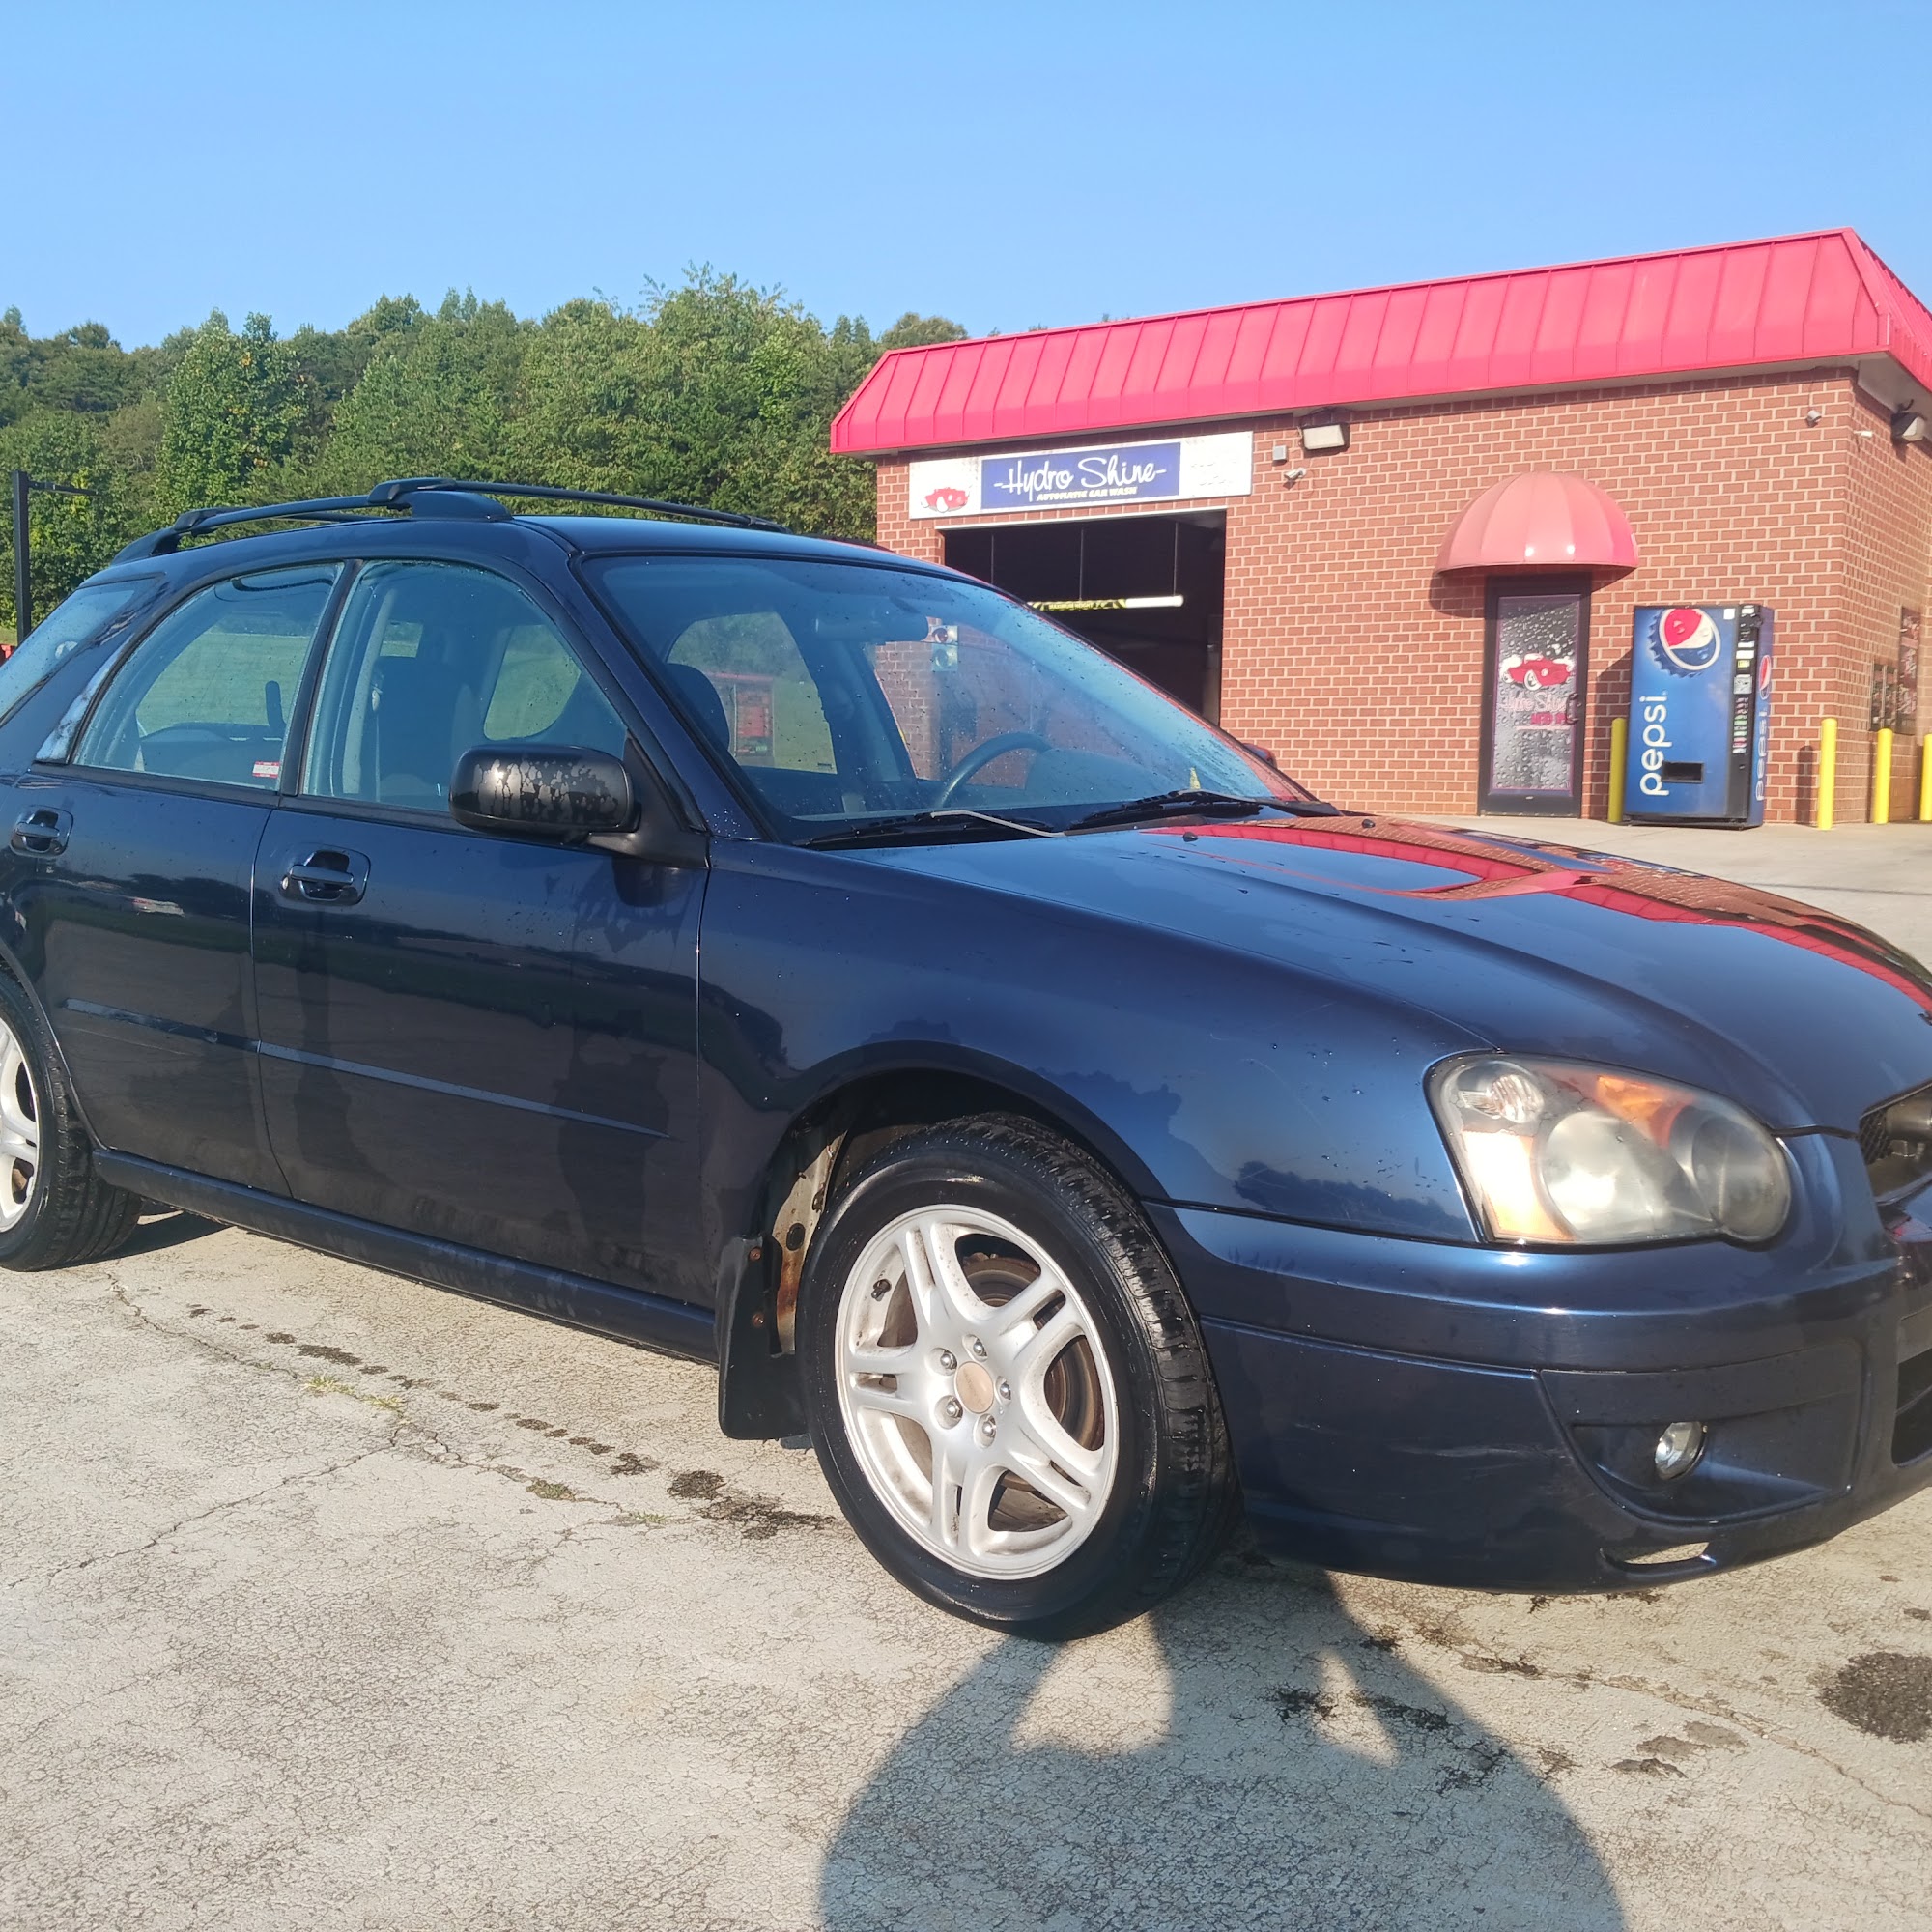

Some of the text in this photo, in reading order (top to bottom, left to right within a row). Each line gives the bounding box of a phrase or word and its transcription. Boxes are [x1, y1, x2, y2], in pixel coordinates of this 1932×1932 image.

[999, 455, 1159, 501] Hydro Shine
[1037, 486, 1138, 501] AUTOMATIC CAR WASH
[1639, 695, 1672, 796] pepsi
